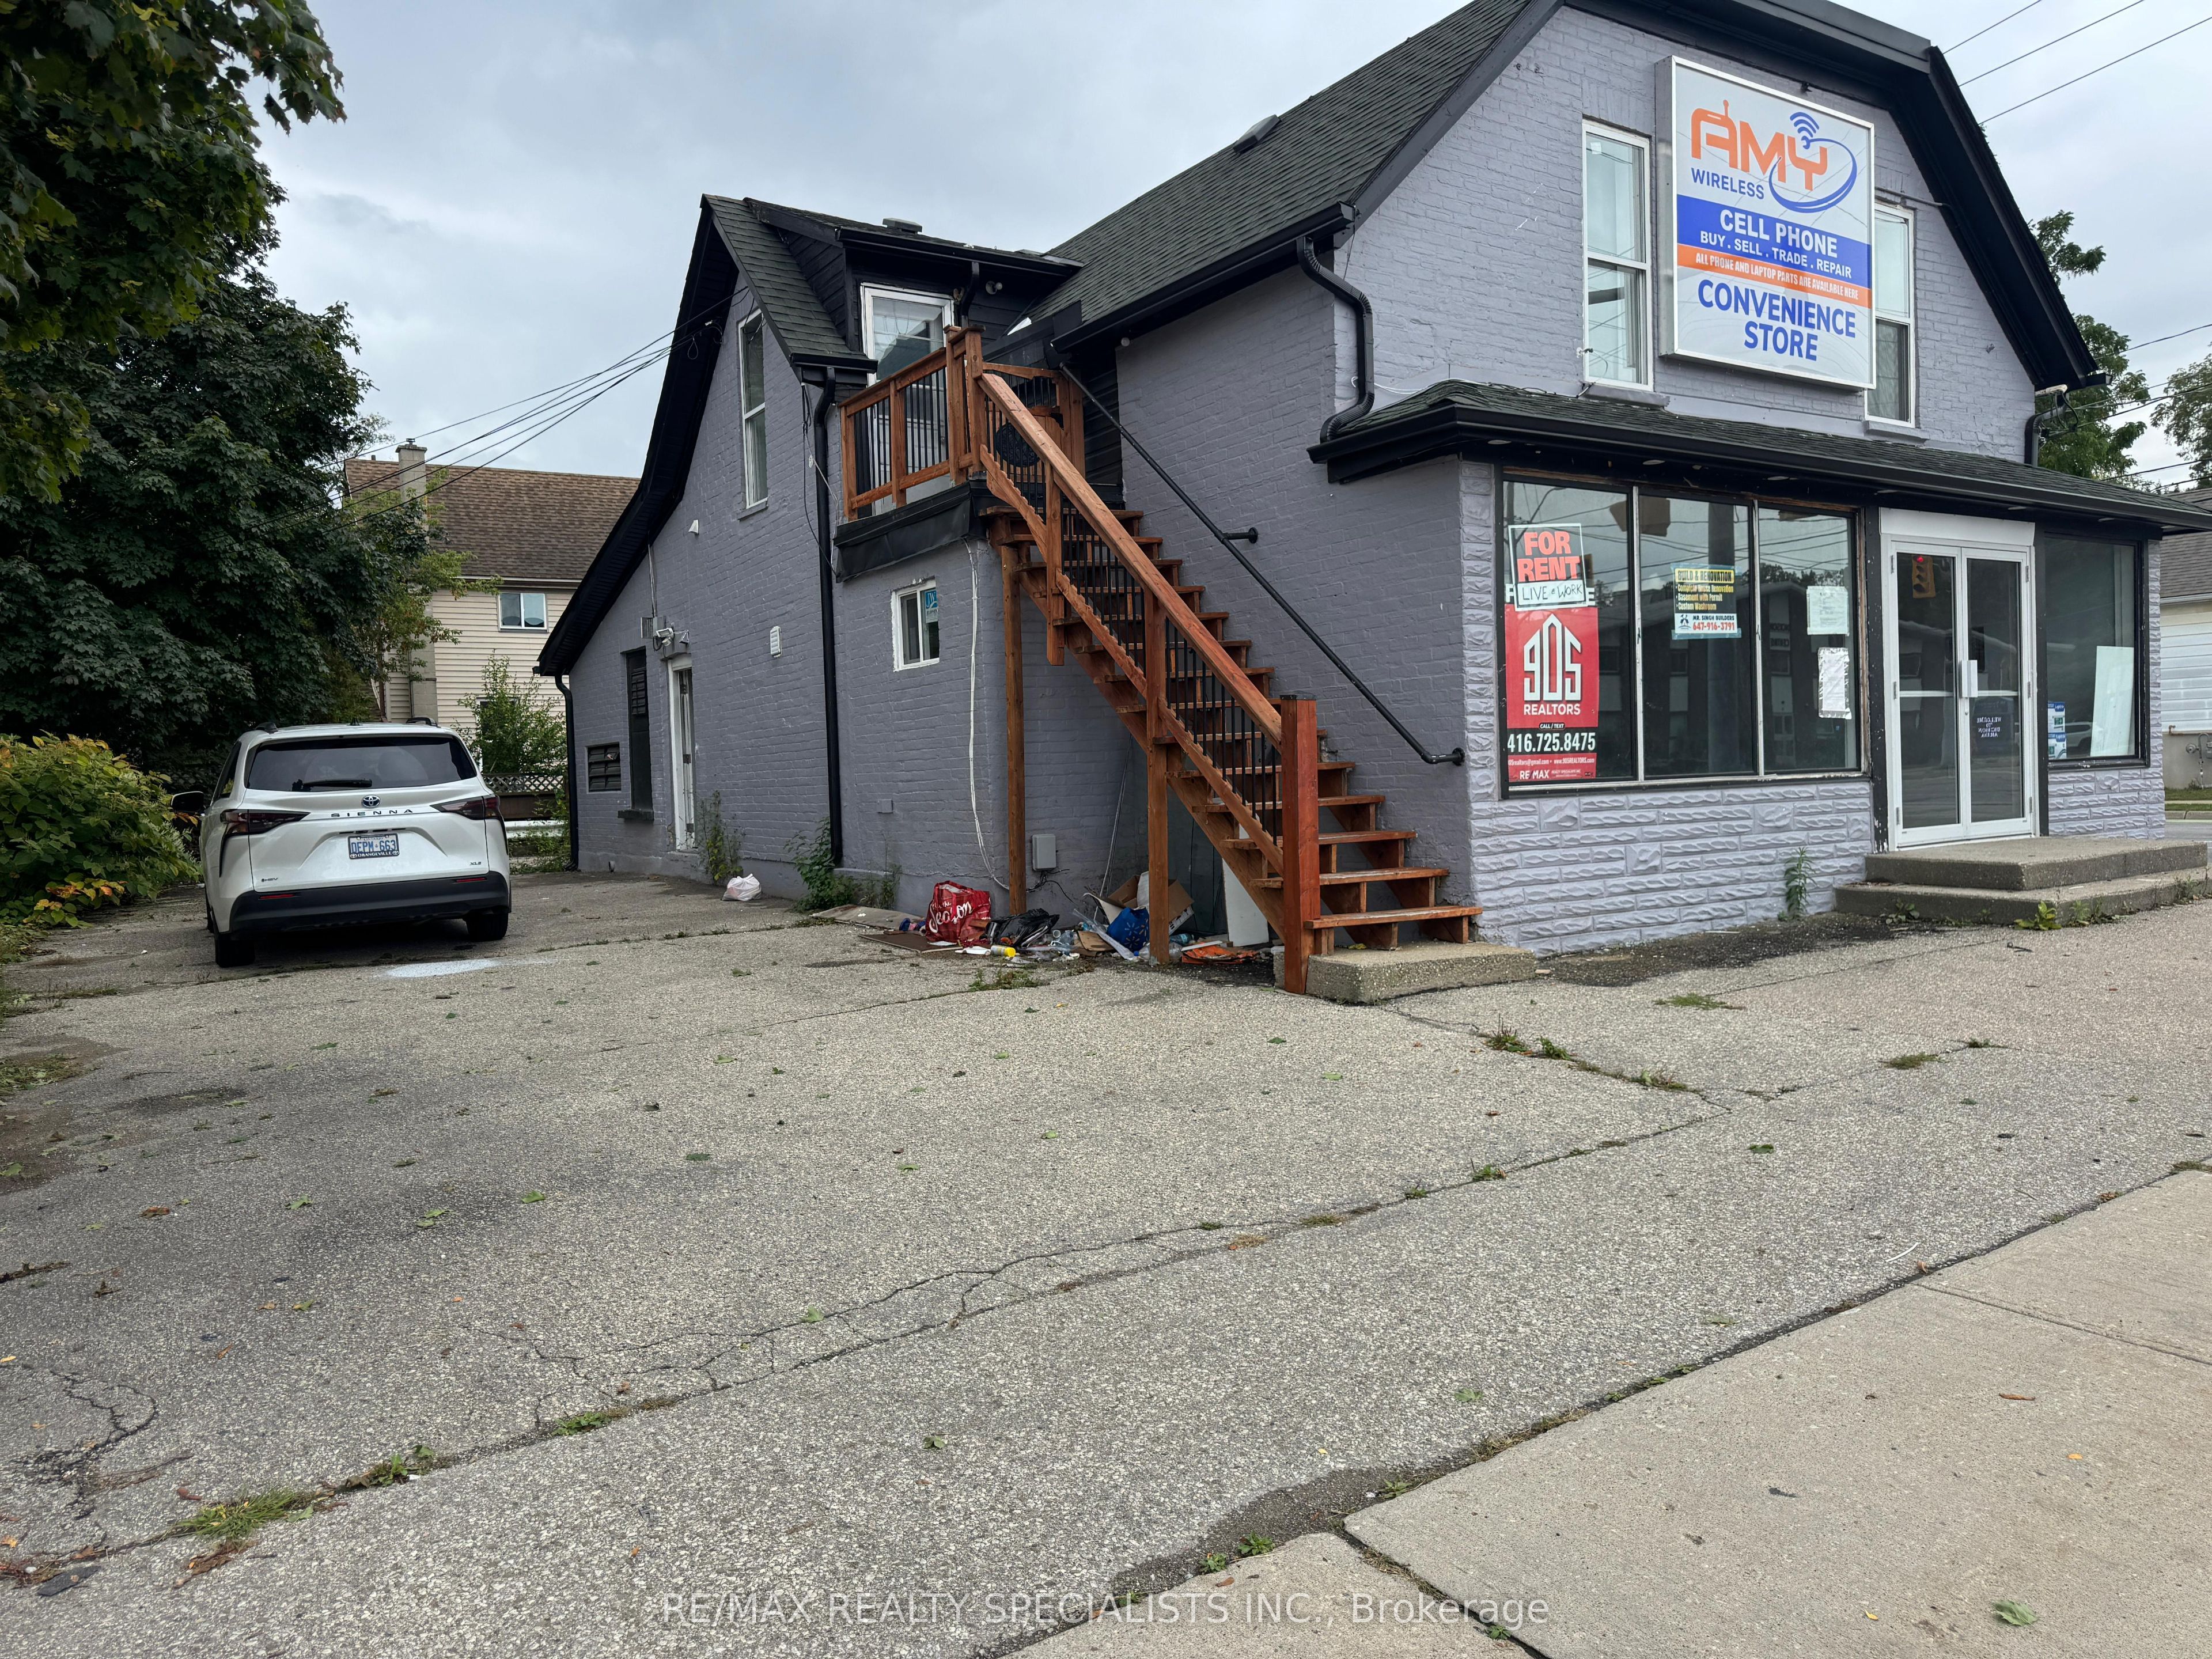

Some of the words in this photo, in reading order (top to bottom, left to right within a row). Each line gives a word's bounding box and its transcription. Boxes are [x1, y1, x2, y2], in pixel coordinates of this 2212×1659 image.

[1691, 100, 1827, 191] AMY
[1691, 168, 1764, 199] WIRELESS
[1720, 209, 1770, 241] CELL
[1775, 222, 1838, 258] PHONE
[1700, 230, 1726, 247] BUY
[1734, 238, 1763, 256] SELL
[1771, 247, 1808, 267] TRADE
[1816, 258, 1852, 279] REPAIR
[1696, 253, 1709, 265] ALL
[1710, 255, 1734, 270] PHONE
[1734, 261, 1749, 274] AND
[1751, 264, 1775, 279] LAPTOP
[1777, 269, 1798, 285] PARTS
[1799, 275, 1812, 287] ARE
[1812, 278, 1844, 296] AVAILABLE
[1844, 288, 1859, 300] HERE
[1698, 279, 1856, 338] CONVENIENCE
[1744, 320, 1818, 361] STORE
[1523, 531, 1571, 556] FOR
[1517, 555, 1581, 582] RENT
[1677, 570, 1693, 581] BUILD
[1695, 570, 1699, 581] &
[1700, 570, 1732, 582] RENOVATION
[1522, 586, 1548, 601] LIVE
[1557, 583, 1583, 599] WORK
[1677, 593, 1699, 601] Basement
[1709, 593, 1723, 601] Permit
[1711, 585, 1734, 593] Renovation
[1678, 602, 1694, 610] Custom
[1695, 603, 1717, 611] Washroom
[1692, 622, 1735, 630] 647-916-3791
[1524, 613, 1581, 701] 905
[1524, 703, 1581, 715] REALTORS
[1507, 732, 1596, 753] 416.725.8475
[1520, 769, 1550, 780] RE/MAX
[331, 809, 413, 818] SIENNA
[351, 841, 374, 854] DEPM
[379, 839, 396, 852] 663
